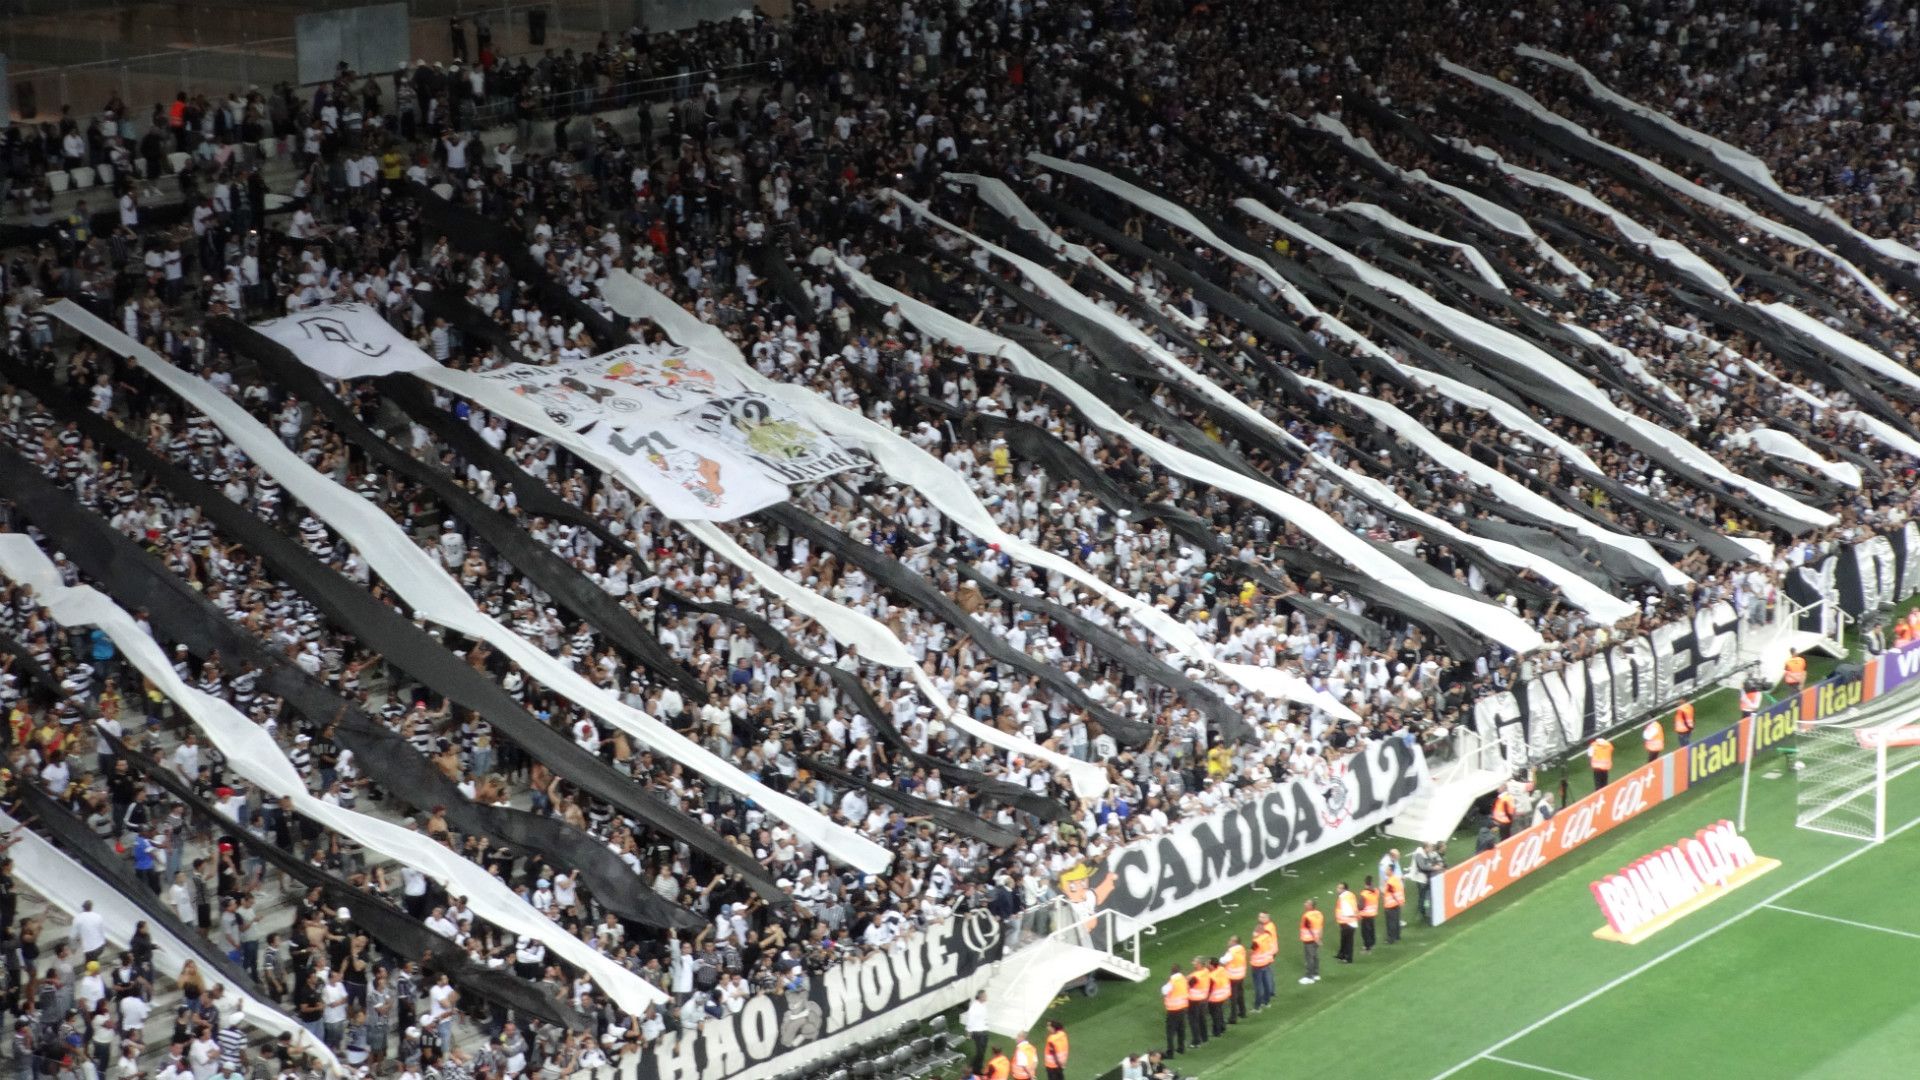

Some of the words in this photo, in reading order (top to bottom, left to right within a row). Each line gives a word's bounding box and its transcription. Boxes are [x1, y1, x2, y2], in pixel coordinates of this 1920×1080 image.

[1690, 729, 1737, 782] Itaú
[1755, 698, 1800, 750] Itaú
[1113, 781, 1323, 917] CAMISA
[1348, 735, 1420, 820] 12
[1590, 845, 1704, 934] BRAHMA
[823, 916, 959, 1034] NOVE
